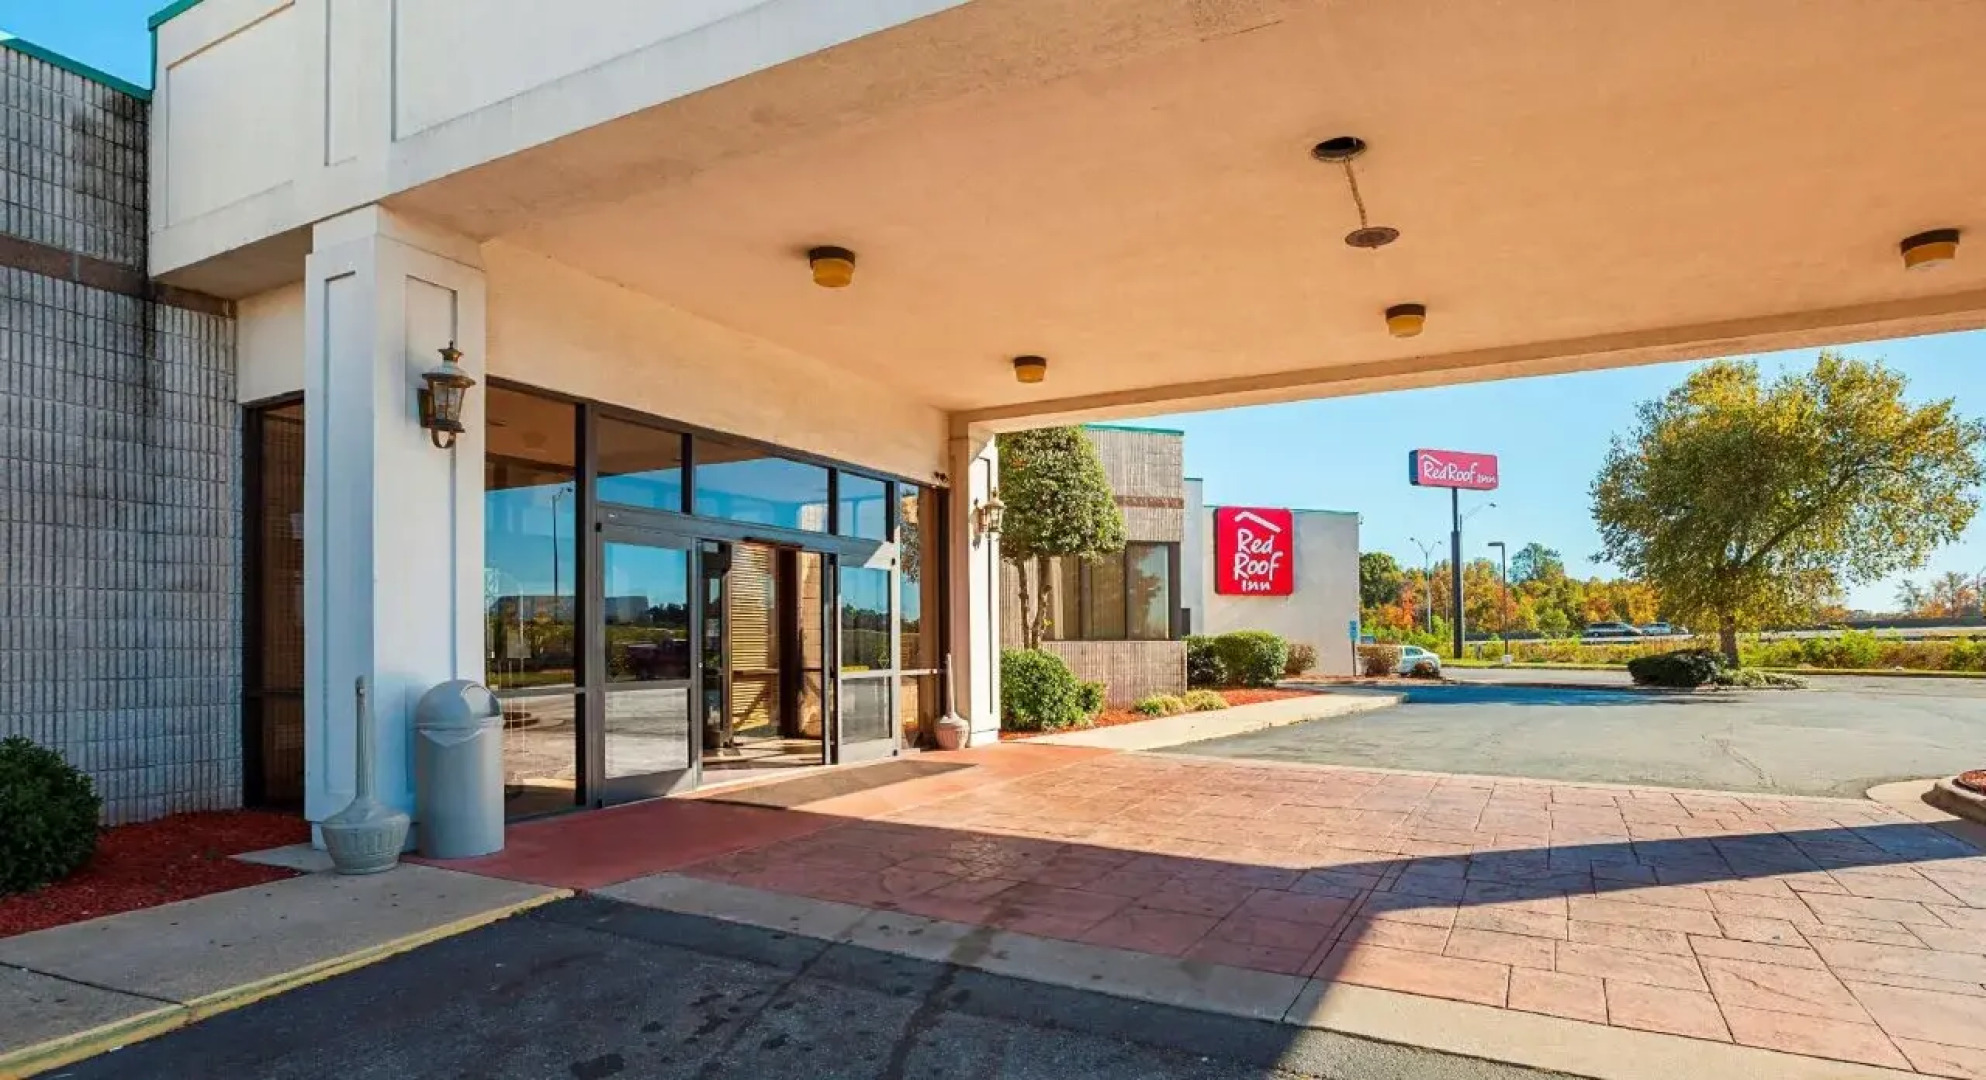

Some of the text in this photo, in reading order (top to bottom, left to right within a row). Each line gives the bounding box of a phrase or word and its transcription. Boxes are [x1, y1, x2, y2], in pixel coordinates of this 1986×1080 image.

[1237, 528, 1275, 554] Red
[1233, 551, 1284, 581] Roof
[1242, 579, 1271, 592] Inn
